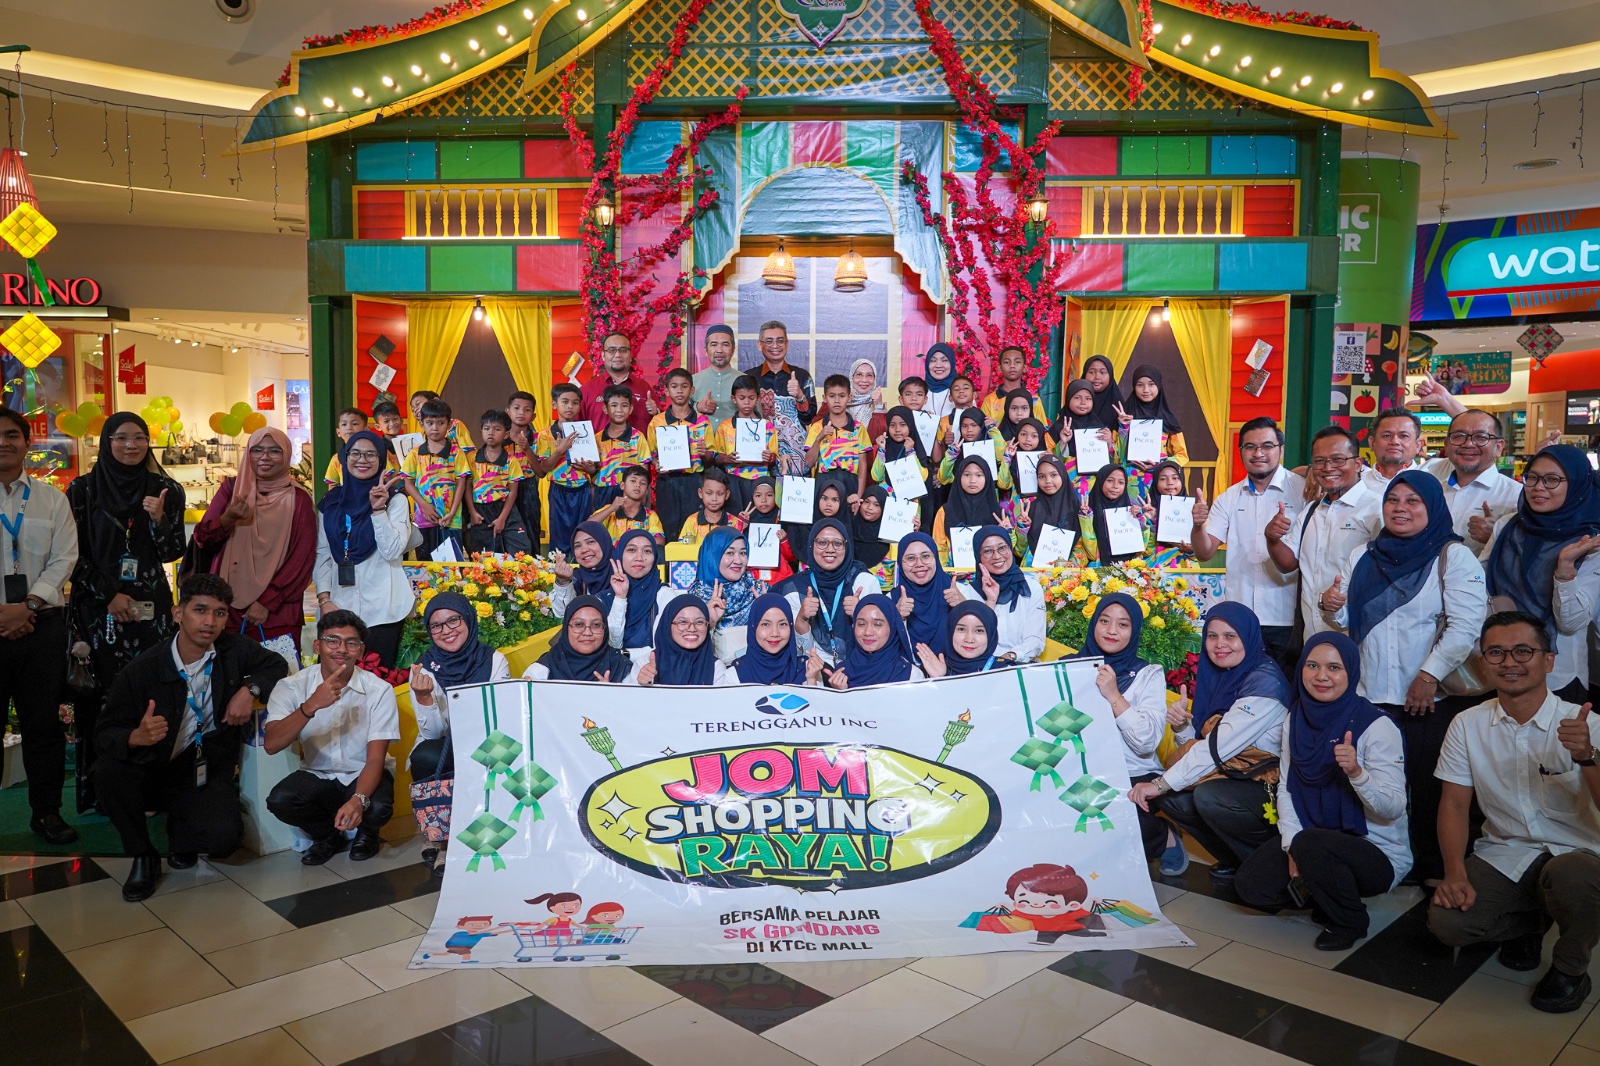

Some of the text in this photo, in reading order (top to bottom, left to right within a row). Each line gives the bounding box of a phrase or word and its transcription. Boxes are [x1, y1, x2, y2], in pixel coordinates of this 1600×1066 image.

[1488, 240, 1600, 279] wat
[690, 716, 878, 733] TERENGGANU INC
[662, 747, 870, 804] JOM
[646, 798, 912, 843] SHOPPING
[679, 833, 890, 878] RAYA!
[719, 905, 881, 925] BERSAMA PELAJAR
[723, 927, 757, 939] SK
[746, 940, 873, 953] DI KTCC MALL
